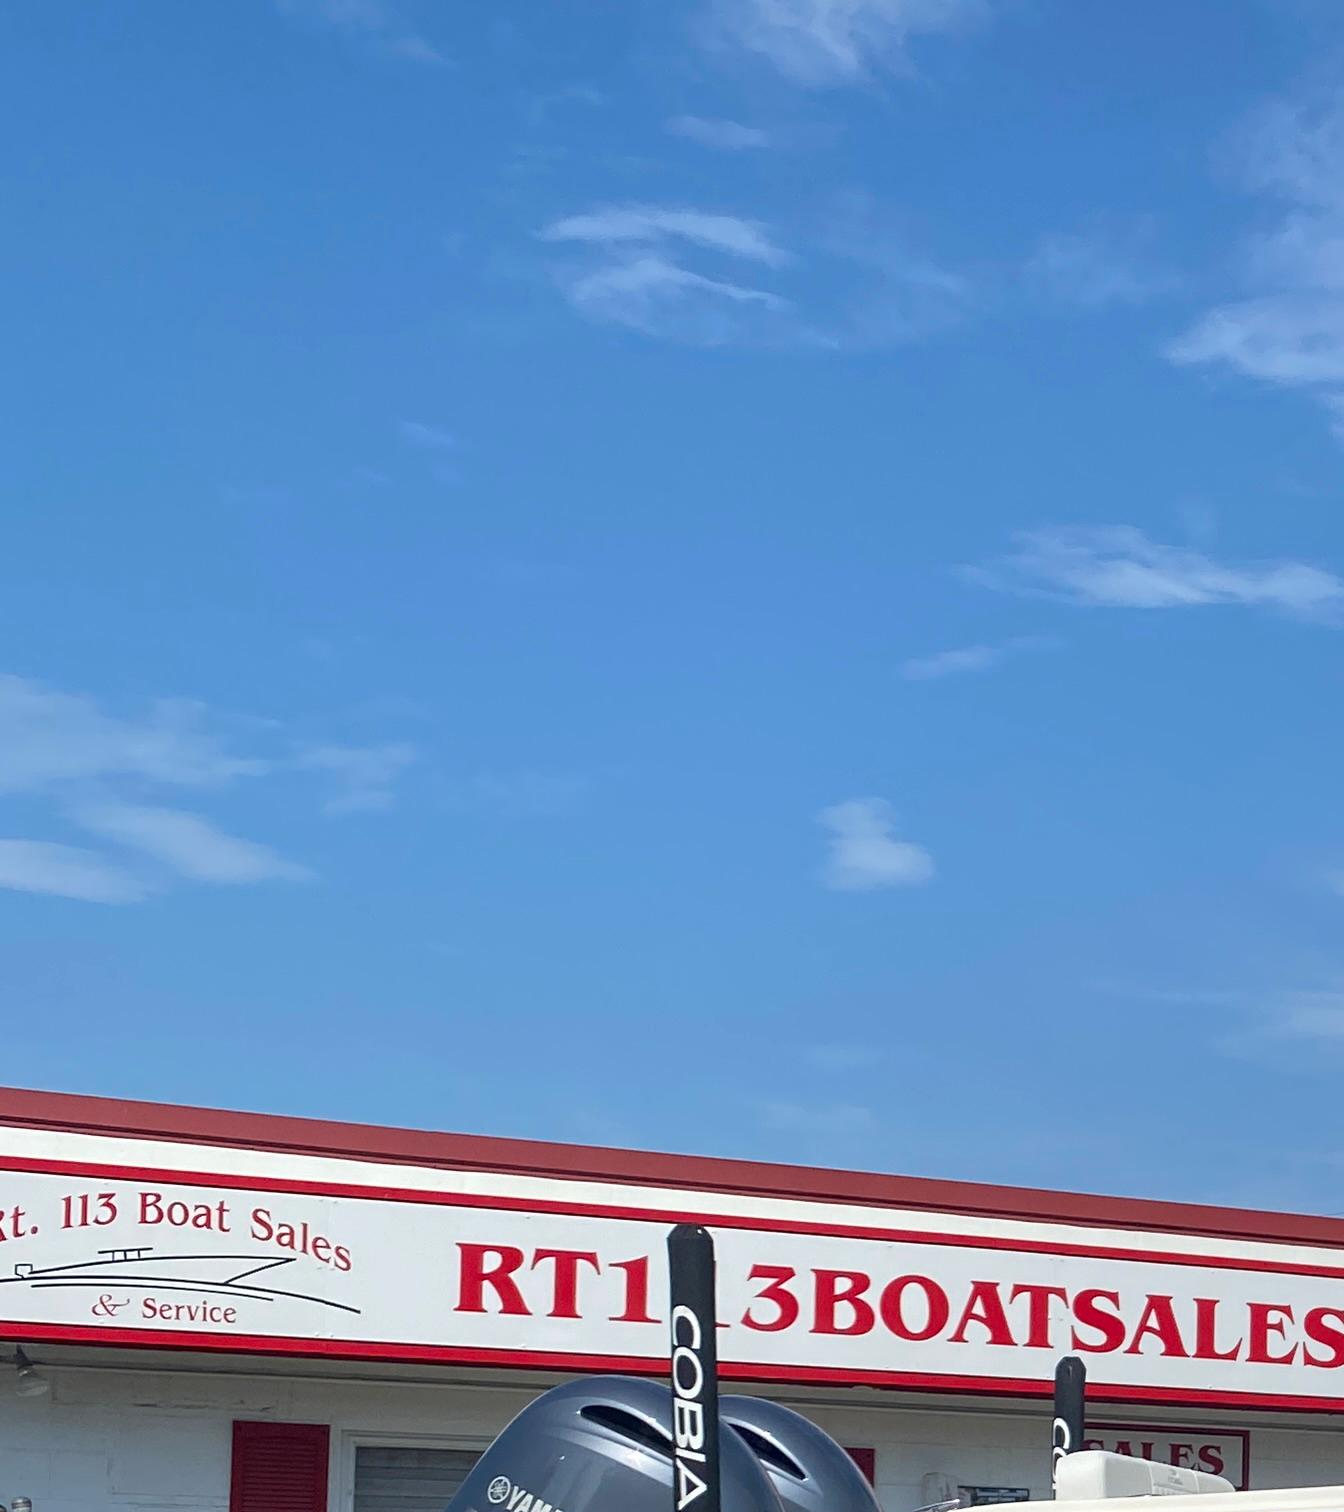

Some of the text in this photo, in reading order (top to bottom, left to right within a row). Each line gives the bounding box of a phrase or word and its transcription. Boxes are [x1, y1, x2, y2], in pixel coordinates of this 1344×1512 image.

[60, 1192, 119, 1229] 113
[138, 1192, 231, 1233] Boat
[250, 1208, 352, 1272] Sales
[91, 1293, 237, 1324] & Service
[672, 1304, 708, 1512] COBIA
